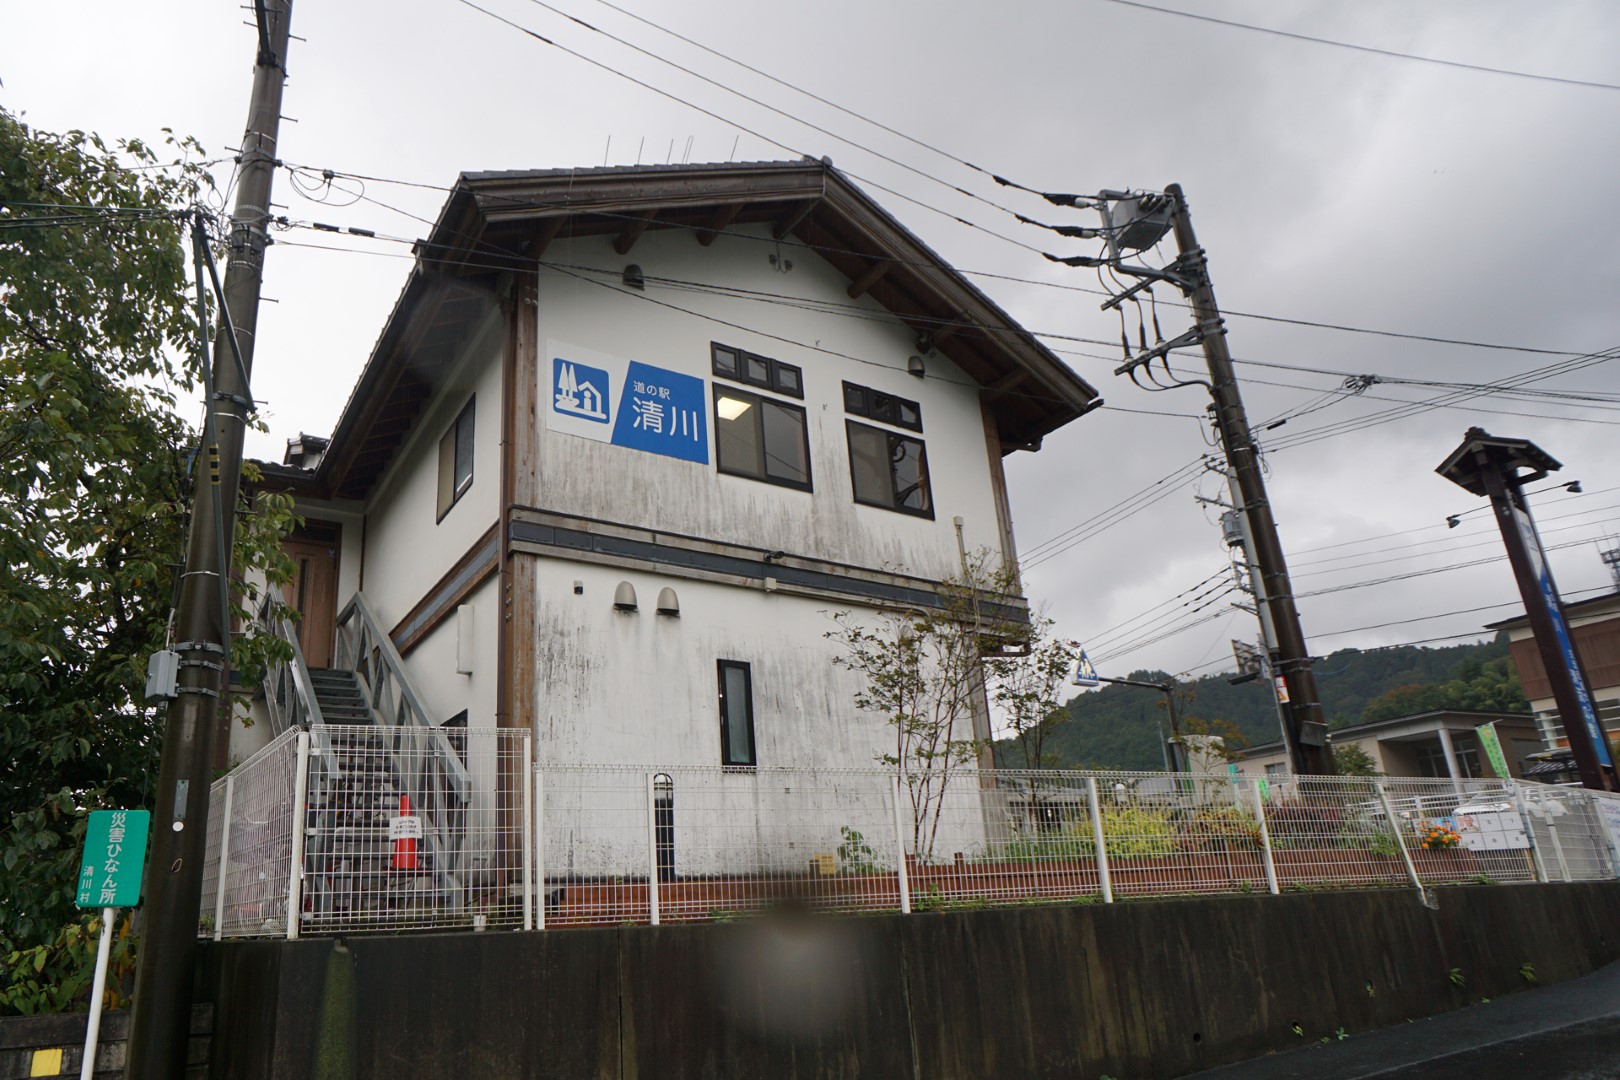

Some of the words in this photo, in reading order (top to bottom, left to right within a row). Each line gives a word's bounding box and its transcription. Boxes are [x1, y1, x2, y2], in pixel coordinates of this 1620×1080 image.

[633, 380, 671, 400] 道の駅
[632, 396, 698, 442] 清川
[98, 812, 127, 905] 災害ひなん所
[79, 865, 94, 903] 清川村
